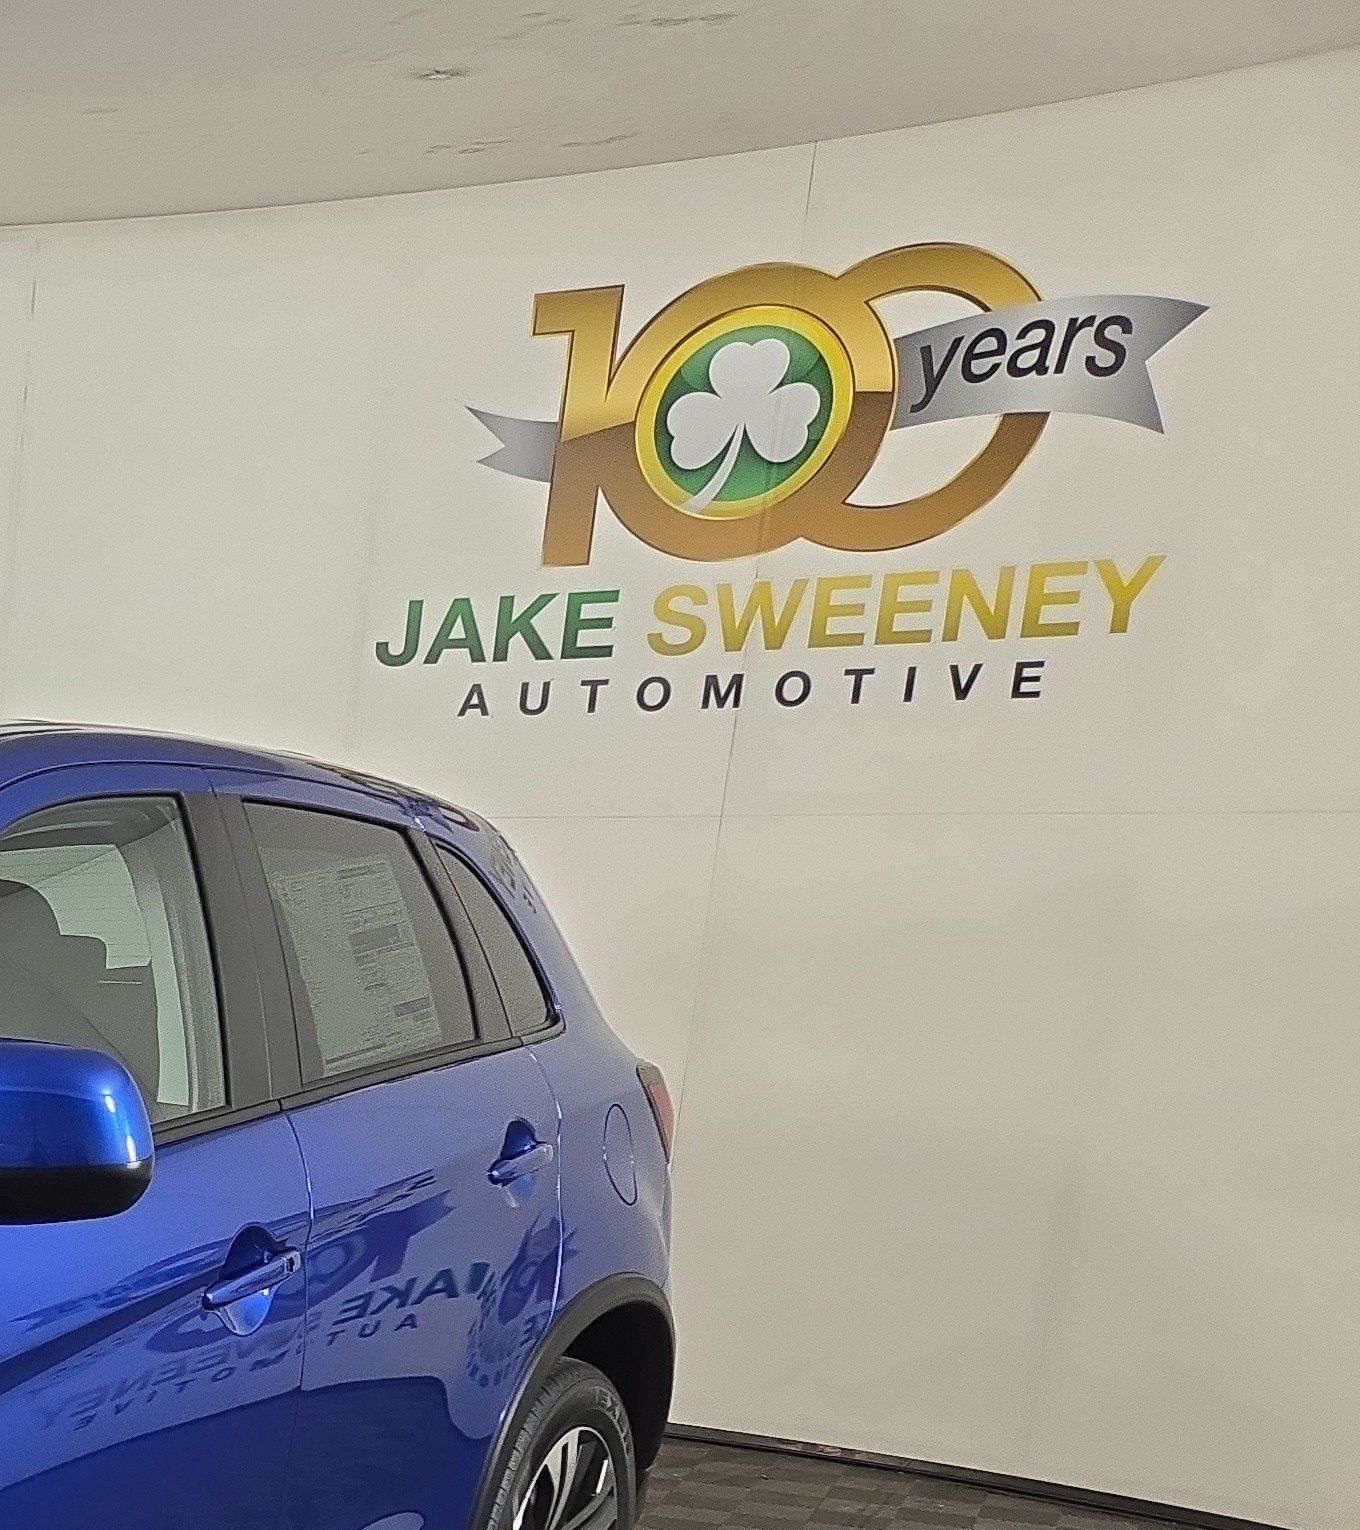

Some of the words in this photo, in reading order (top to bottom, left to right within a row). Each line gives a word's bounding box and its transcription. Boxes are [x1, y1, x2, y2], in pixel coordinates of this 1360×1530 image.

[532, 241, 1052, 568] 100
[911, 313, 1135, 414] years
[374, 589, 621, 667] JAKE
[646, 554, 1166, 656] SWEENEY
[456, 660, 1047, 718] AUTOMOTIVE
